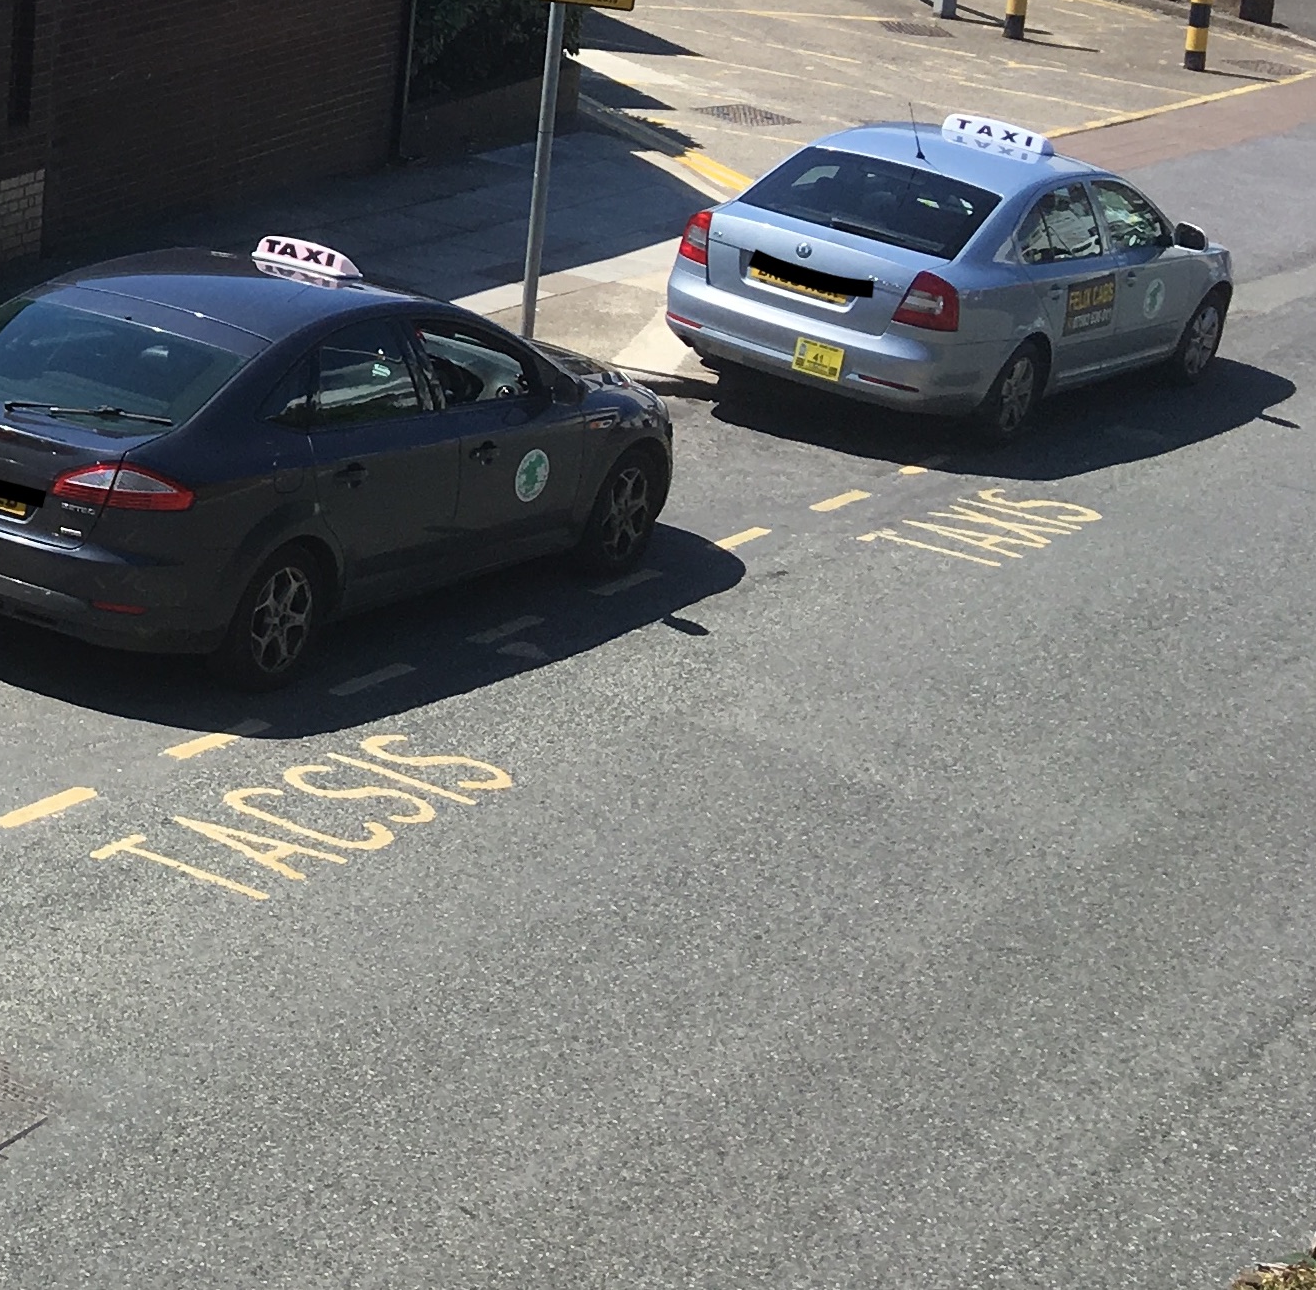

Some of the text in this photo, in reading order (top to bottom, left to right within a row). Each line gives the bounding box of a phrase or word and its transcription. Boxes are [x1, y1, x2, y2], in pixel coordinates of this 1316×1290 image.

[956, 118, 1034, 147] TAXI
[266, 238, 335, 267] TAXI
[1069, 282, 1115, 310] FELIX CABS
[813, 353, 824, 363] 41
[856, 487, 1103, 568] TAXIS
[89, 734, 514, 900] TACSIS
